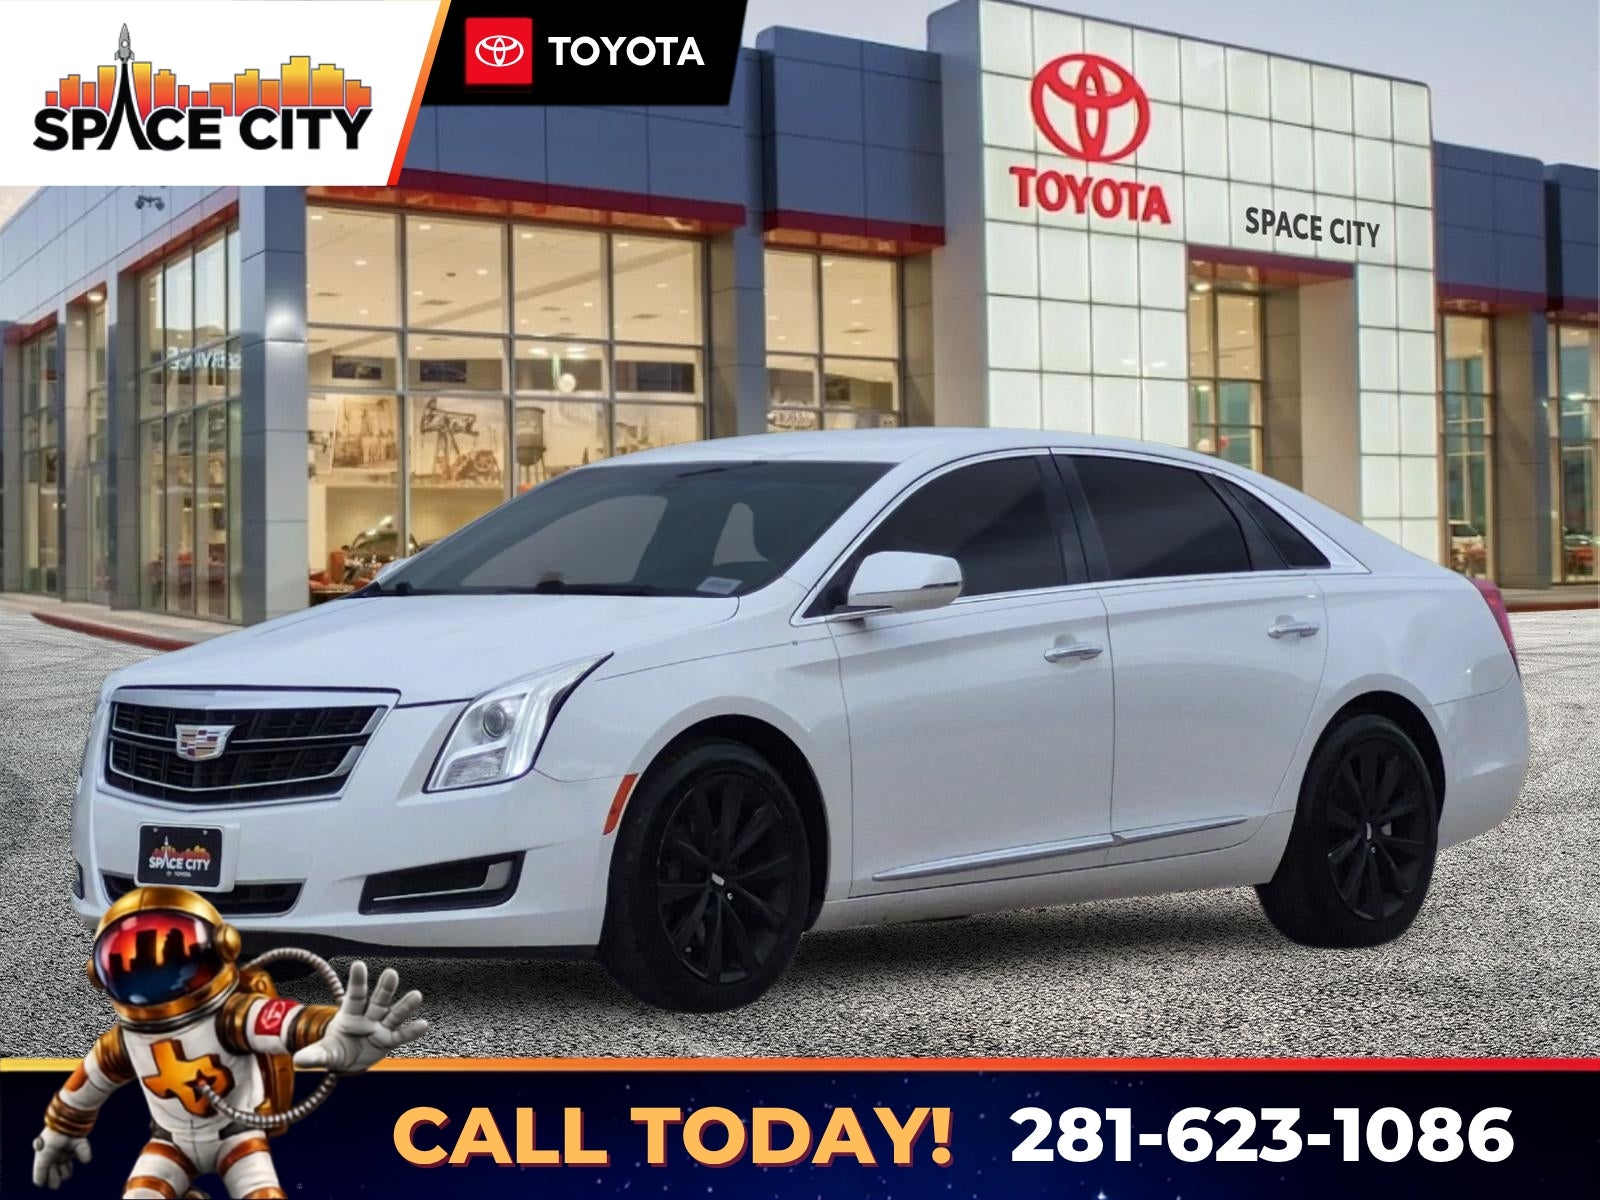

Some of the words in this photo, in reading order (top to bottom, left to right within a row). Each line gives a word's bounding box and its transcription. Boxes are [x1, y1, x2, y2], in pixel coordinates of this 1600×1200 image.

[1009, 166, 1172, 225] TOYOTA
[1245, 206, 1323, 242] SPACE
[1329, 218, 1380, 248] CITY
[148, 855, 184, 870] SPACE
[185, 858, 211, 871] CITY
